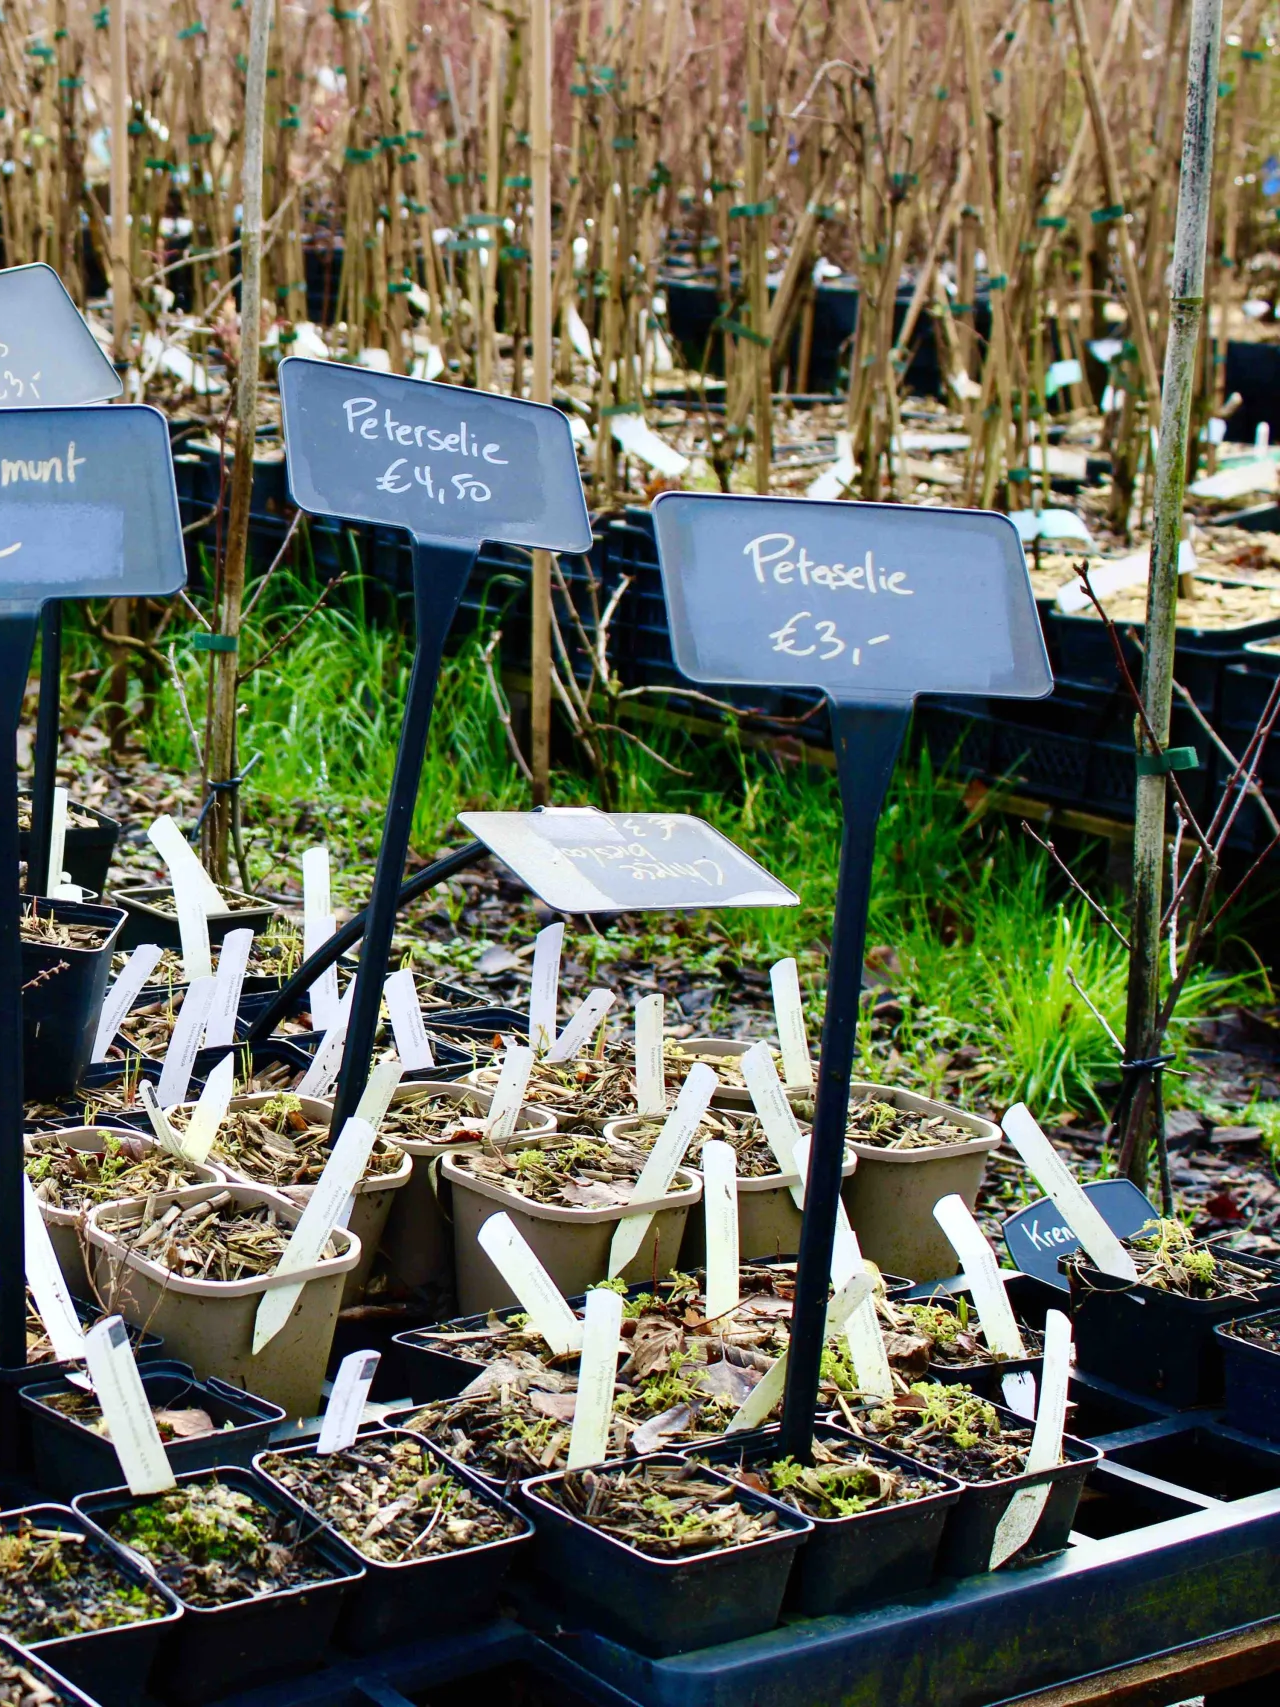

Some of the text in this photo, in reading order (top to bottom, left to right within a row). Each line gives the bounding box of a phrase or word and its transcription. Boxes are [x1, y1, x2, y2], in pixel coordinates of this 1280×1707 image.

[342, 396, 510, 465] Peterselie
[375, 457, 493, 505] €4,50
[768, 611, 891, 667] €3,-
